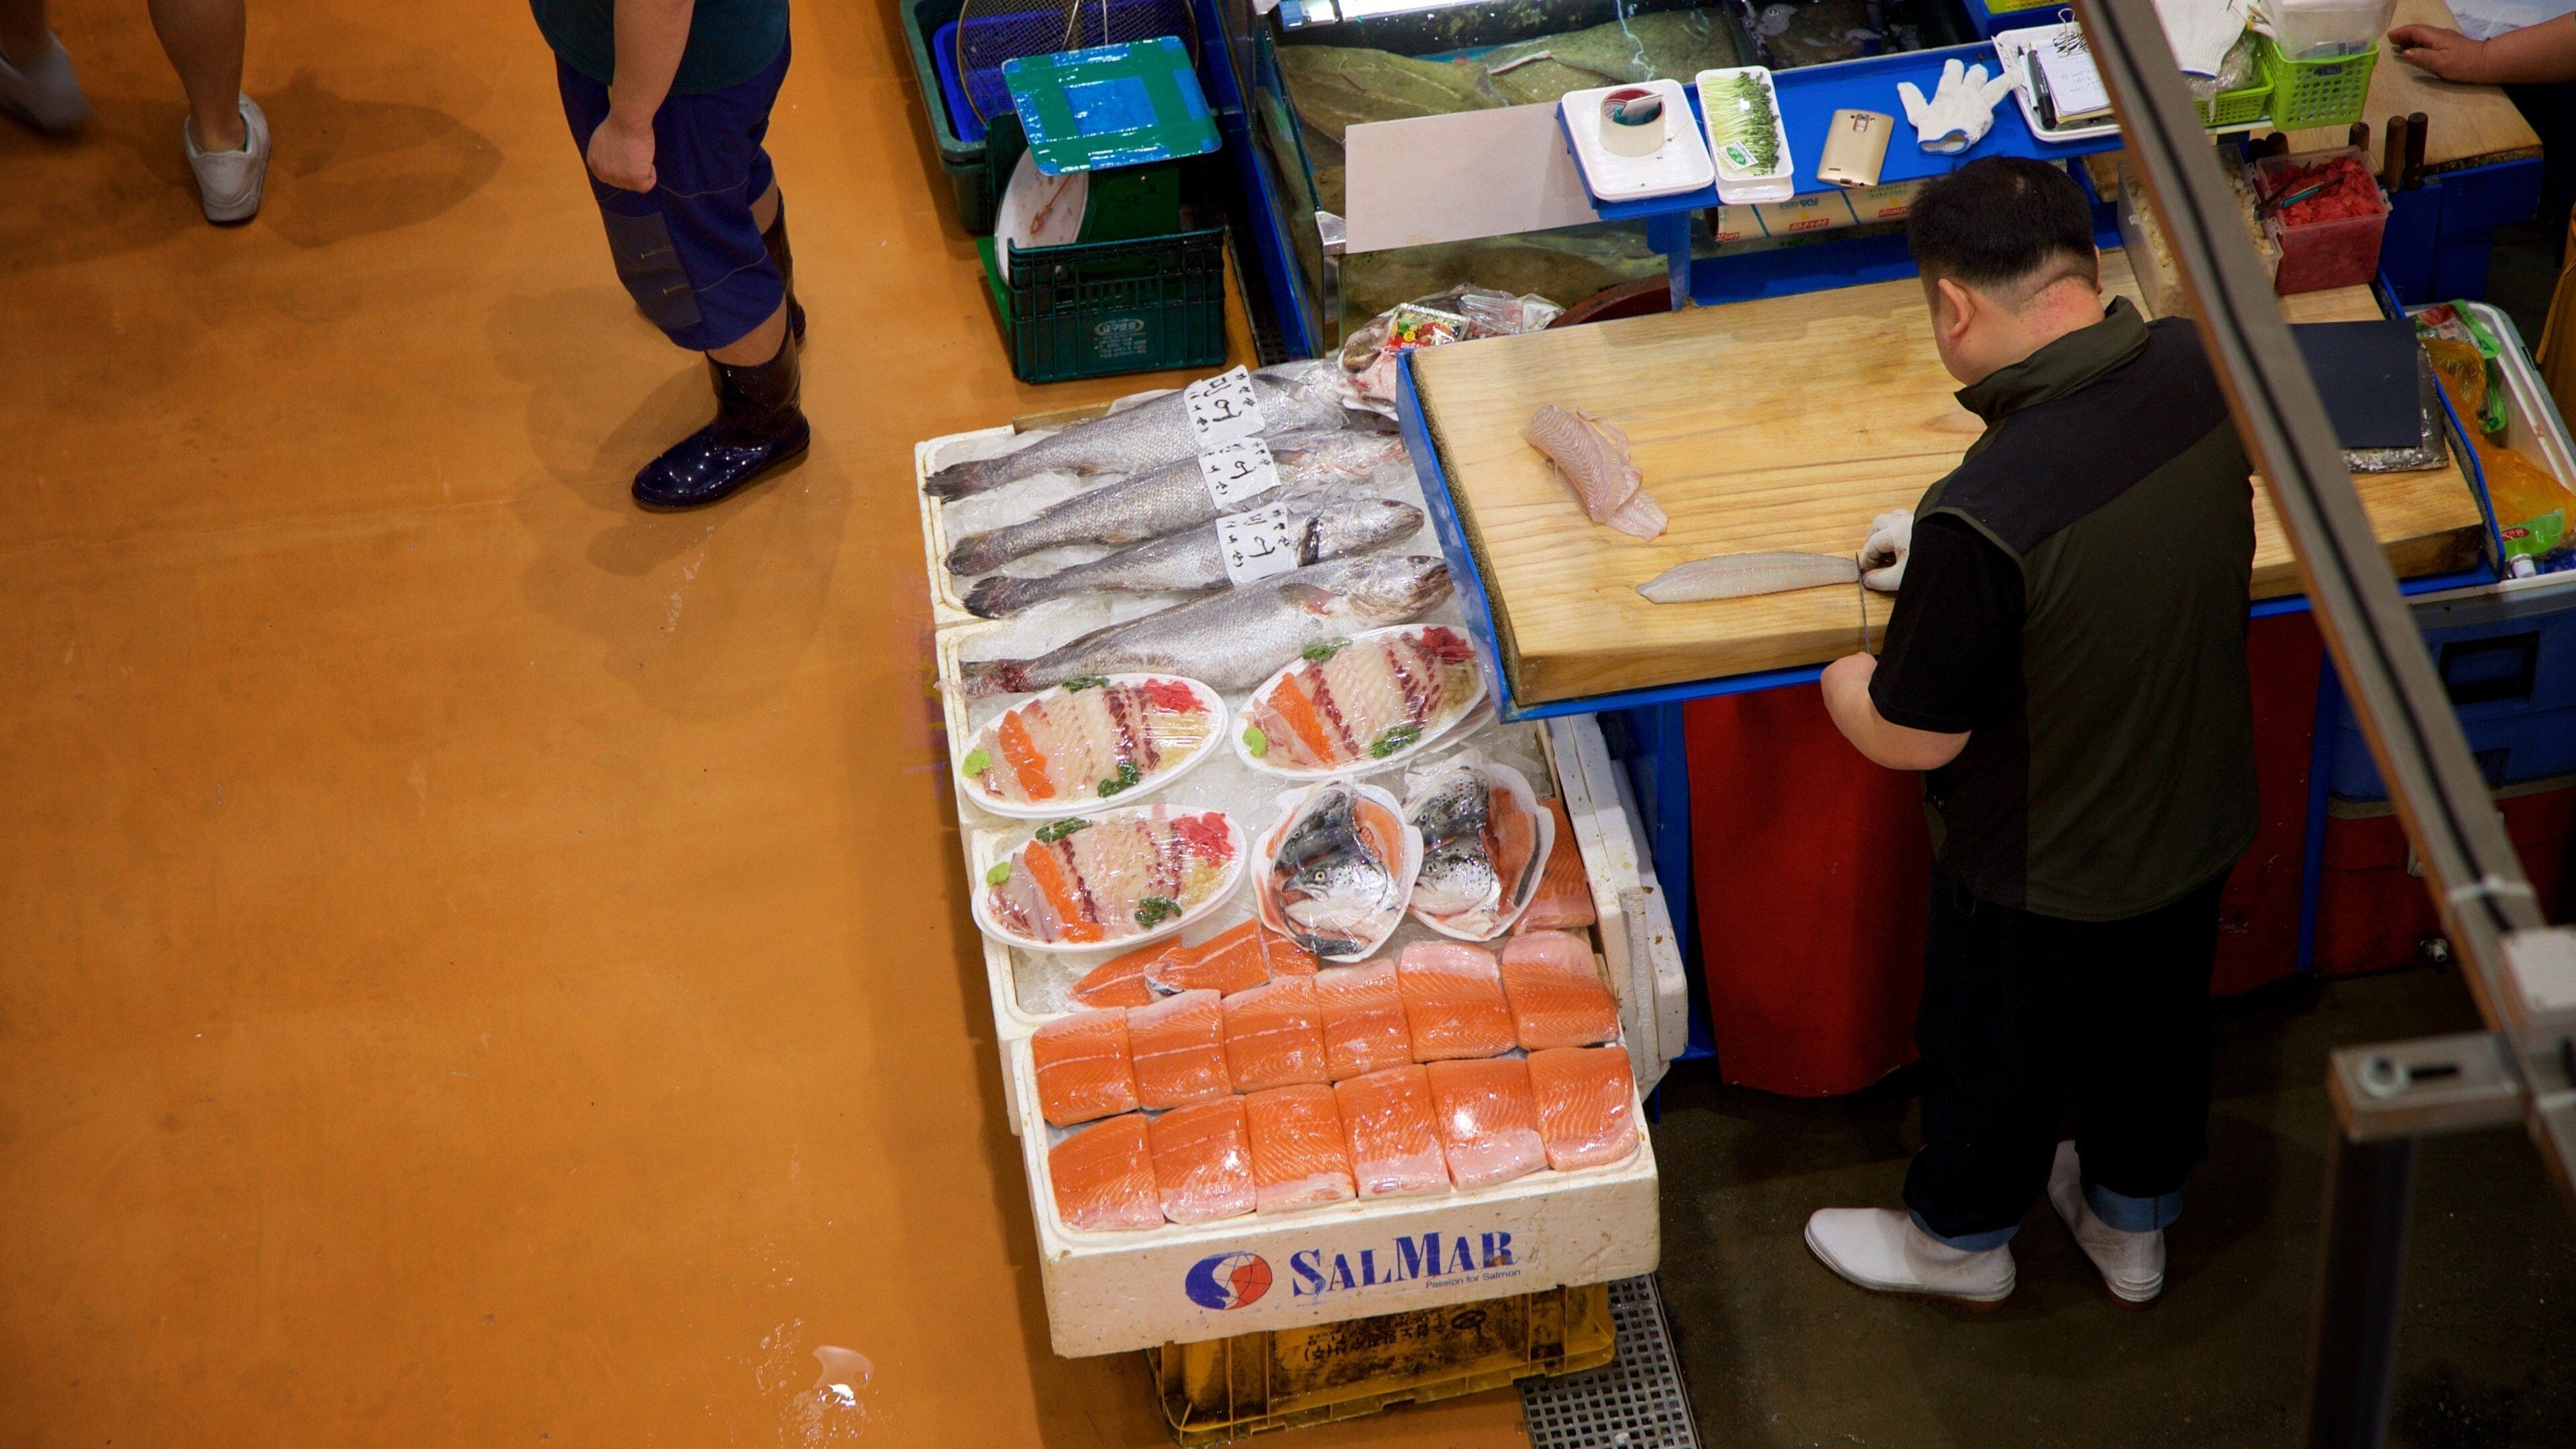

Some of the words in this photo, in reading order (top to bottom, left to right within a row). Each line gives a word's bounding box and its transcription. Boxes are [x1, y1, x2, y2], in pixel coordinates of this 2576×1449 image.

[1426, 1276, 1464, 1289] Passion
[1466, 1273, 1480, 1283] for
[1483, 1269, 1521, 1281] Salmon
